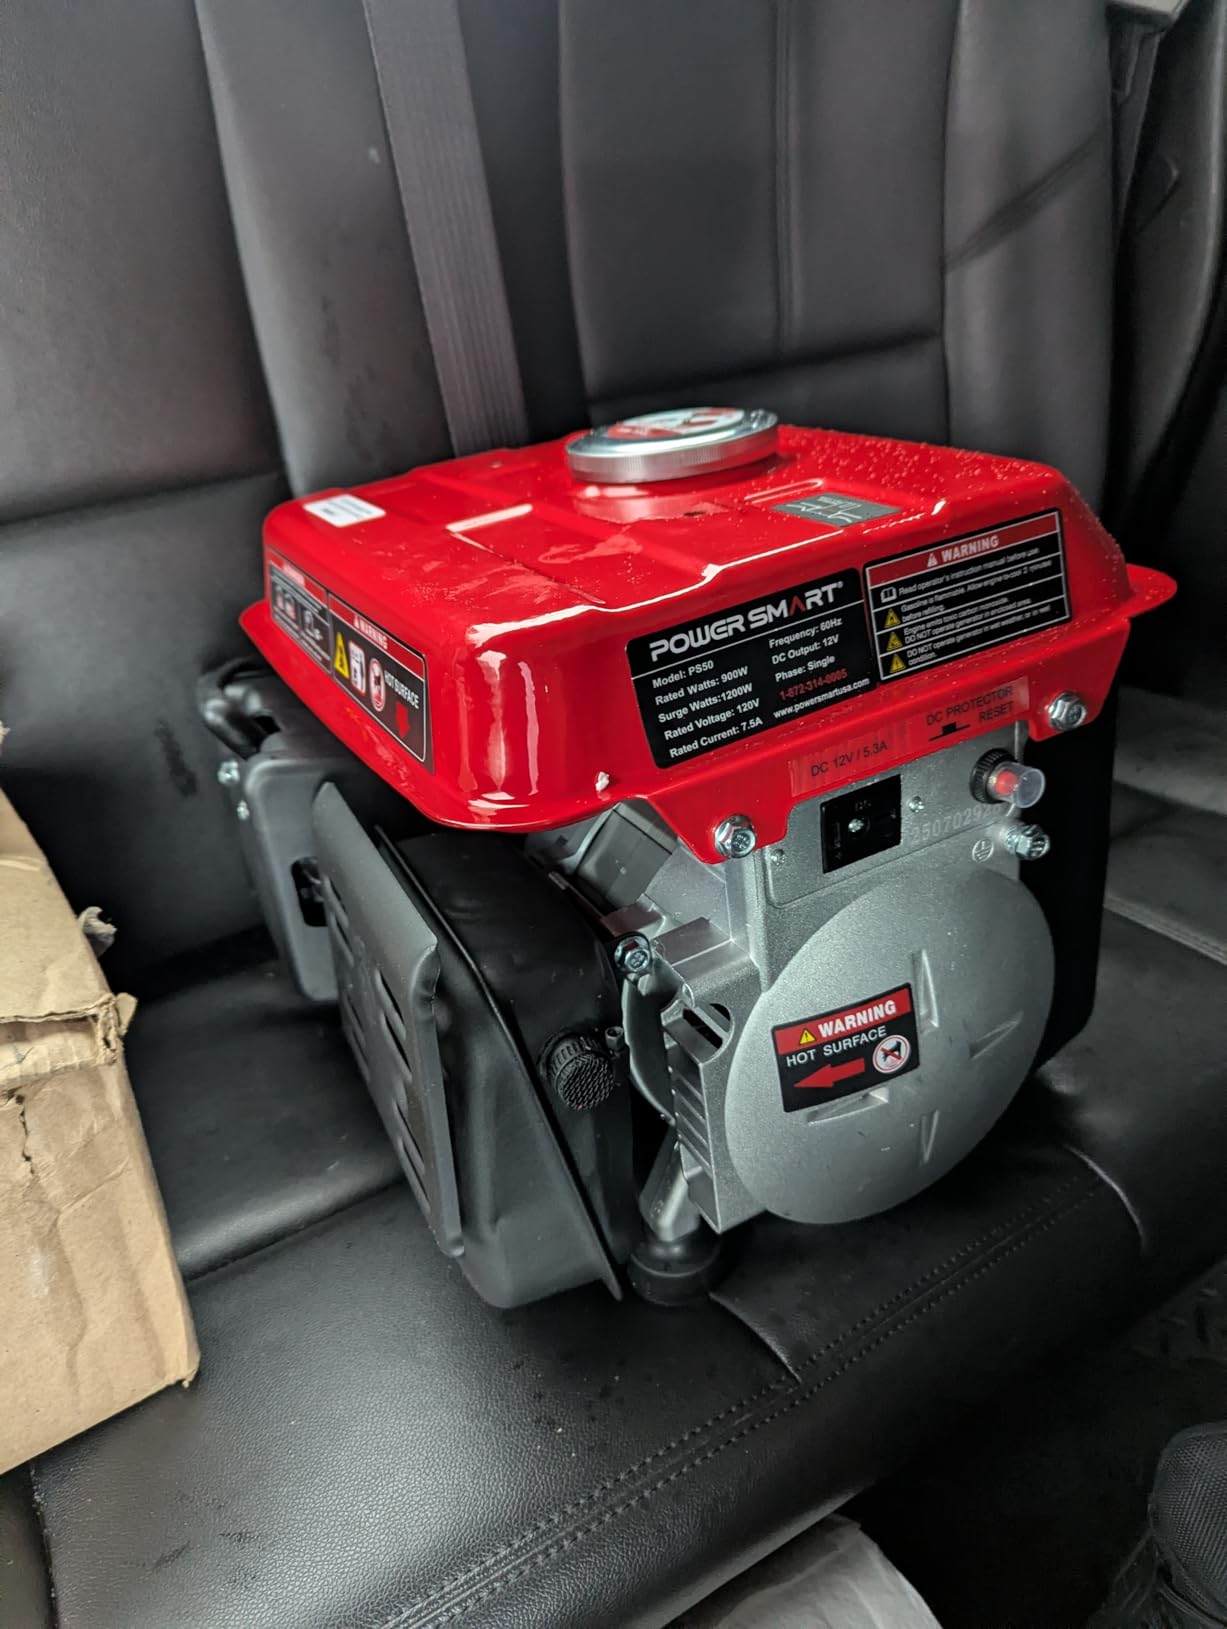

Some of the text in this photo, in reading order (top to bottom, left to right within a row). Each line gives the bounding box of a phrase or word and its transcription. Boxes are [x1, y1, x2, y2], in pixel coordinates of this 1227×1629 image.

[941, 535, 999, 562] WARNING
[899, 584, 917, 596] Read
[951, 564, 982, 579] instruction
[901, 599, 928, 613] Gasoline
[928, 597, 934, 605] is
[966, 580, 983, 592] Allow
[983, 576, 1003, 588] engine
[360, 618, 388, 650] WARNING
[769, 617, 843, 649] Frequency: 60Hz
[902, 611, 922, 624] before
[903, 624, 926, 636] Engine
[926, 618, 943, 629] emits
[943, 613, 958, 623] toxic
[958, 606, 979, 618] carbon
[904, 635, 916, 645] DO
[916, 629, 932, 640] NOT
[932, 623, 955, 635] operate
[955, 613, 984, 629] generator
[983, 611, 990, 619] in
[990, 601, 1017, 616] enclosed
[650, 614, 745, 662] POWER
[772, 634, 840, 665] DC Output: 12V
[906, 648, 918, 658] DO
[918, 643, 933, 654] NOT
[933, 637, 956, 649] operate
[956, 628, 984, 643] generator
[652, 660, 714, 689] Model: PS50
[655, 666, 748, 706] Rated Watts: 900W
[775, 655, 835, 683] Phase: Single
[383, 670, 419, 710] HOT SURFACE
[773, 678, 870, 719] www.powersmartusa.com
[926, 685, 1014, 726] DC PROTECTOR
[658, 705, 688, 724] Surge
[664, 698, 760, 741] Rated Voltage: 120V
[979, 701, 1014, 722] RESET
[669, 716, 764, 759] Rated Current: 7.5A
[810, 763, 829, 777] DC
[833, 753, 854, 770] 12V
[864, 740, 888, 758] 5.3A
[818, 1000, 897, 1038] WARNING
[786, 1025, 888, 1067] HOT SURFACE
